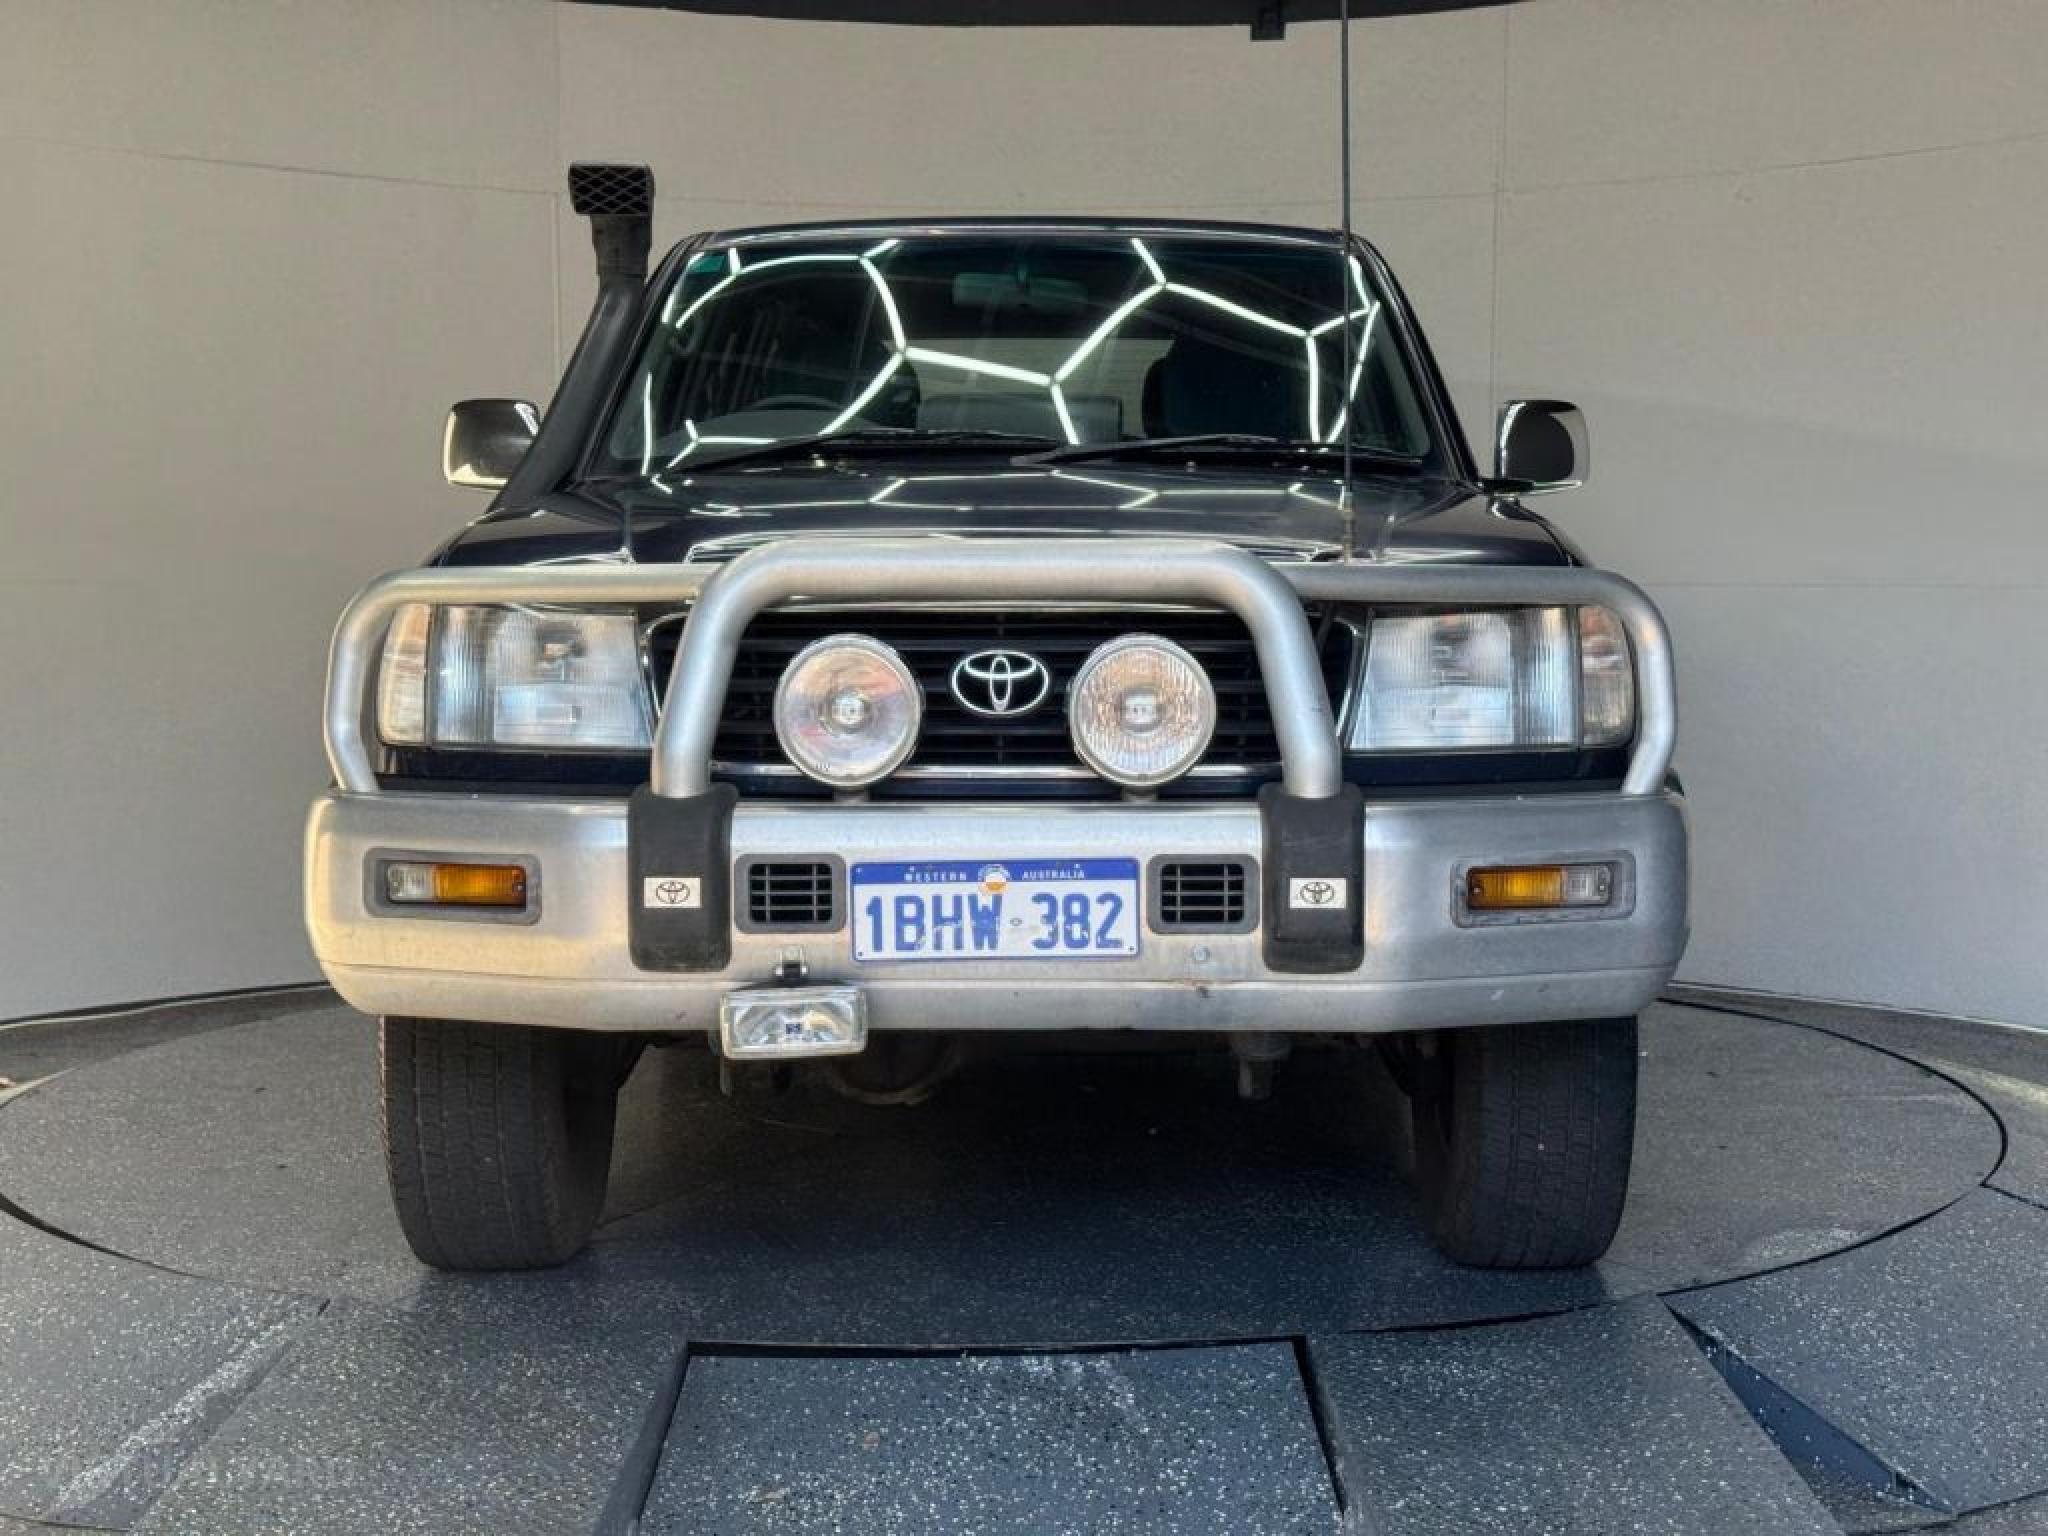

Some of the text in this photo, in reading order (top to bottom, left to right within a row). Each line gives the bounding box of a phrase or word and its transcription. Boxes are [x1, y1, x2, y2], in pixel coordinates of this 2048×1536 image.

[903, 869, 1085, 882] WESTERN AUSTRALIA
[866, 892, 1123, 952] 1BHW 382
